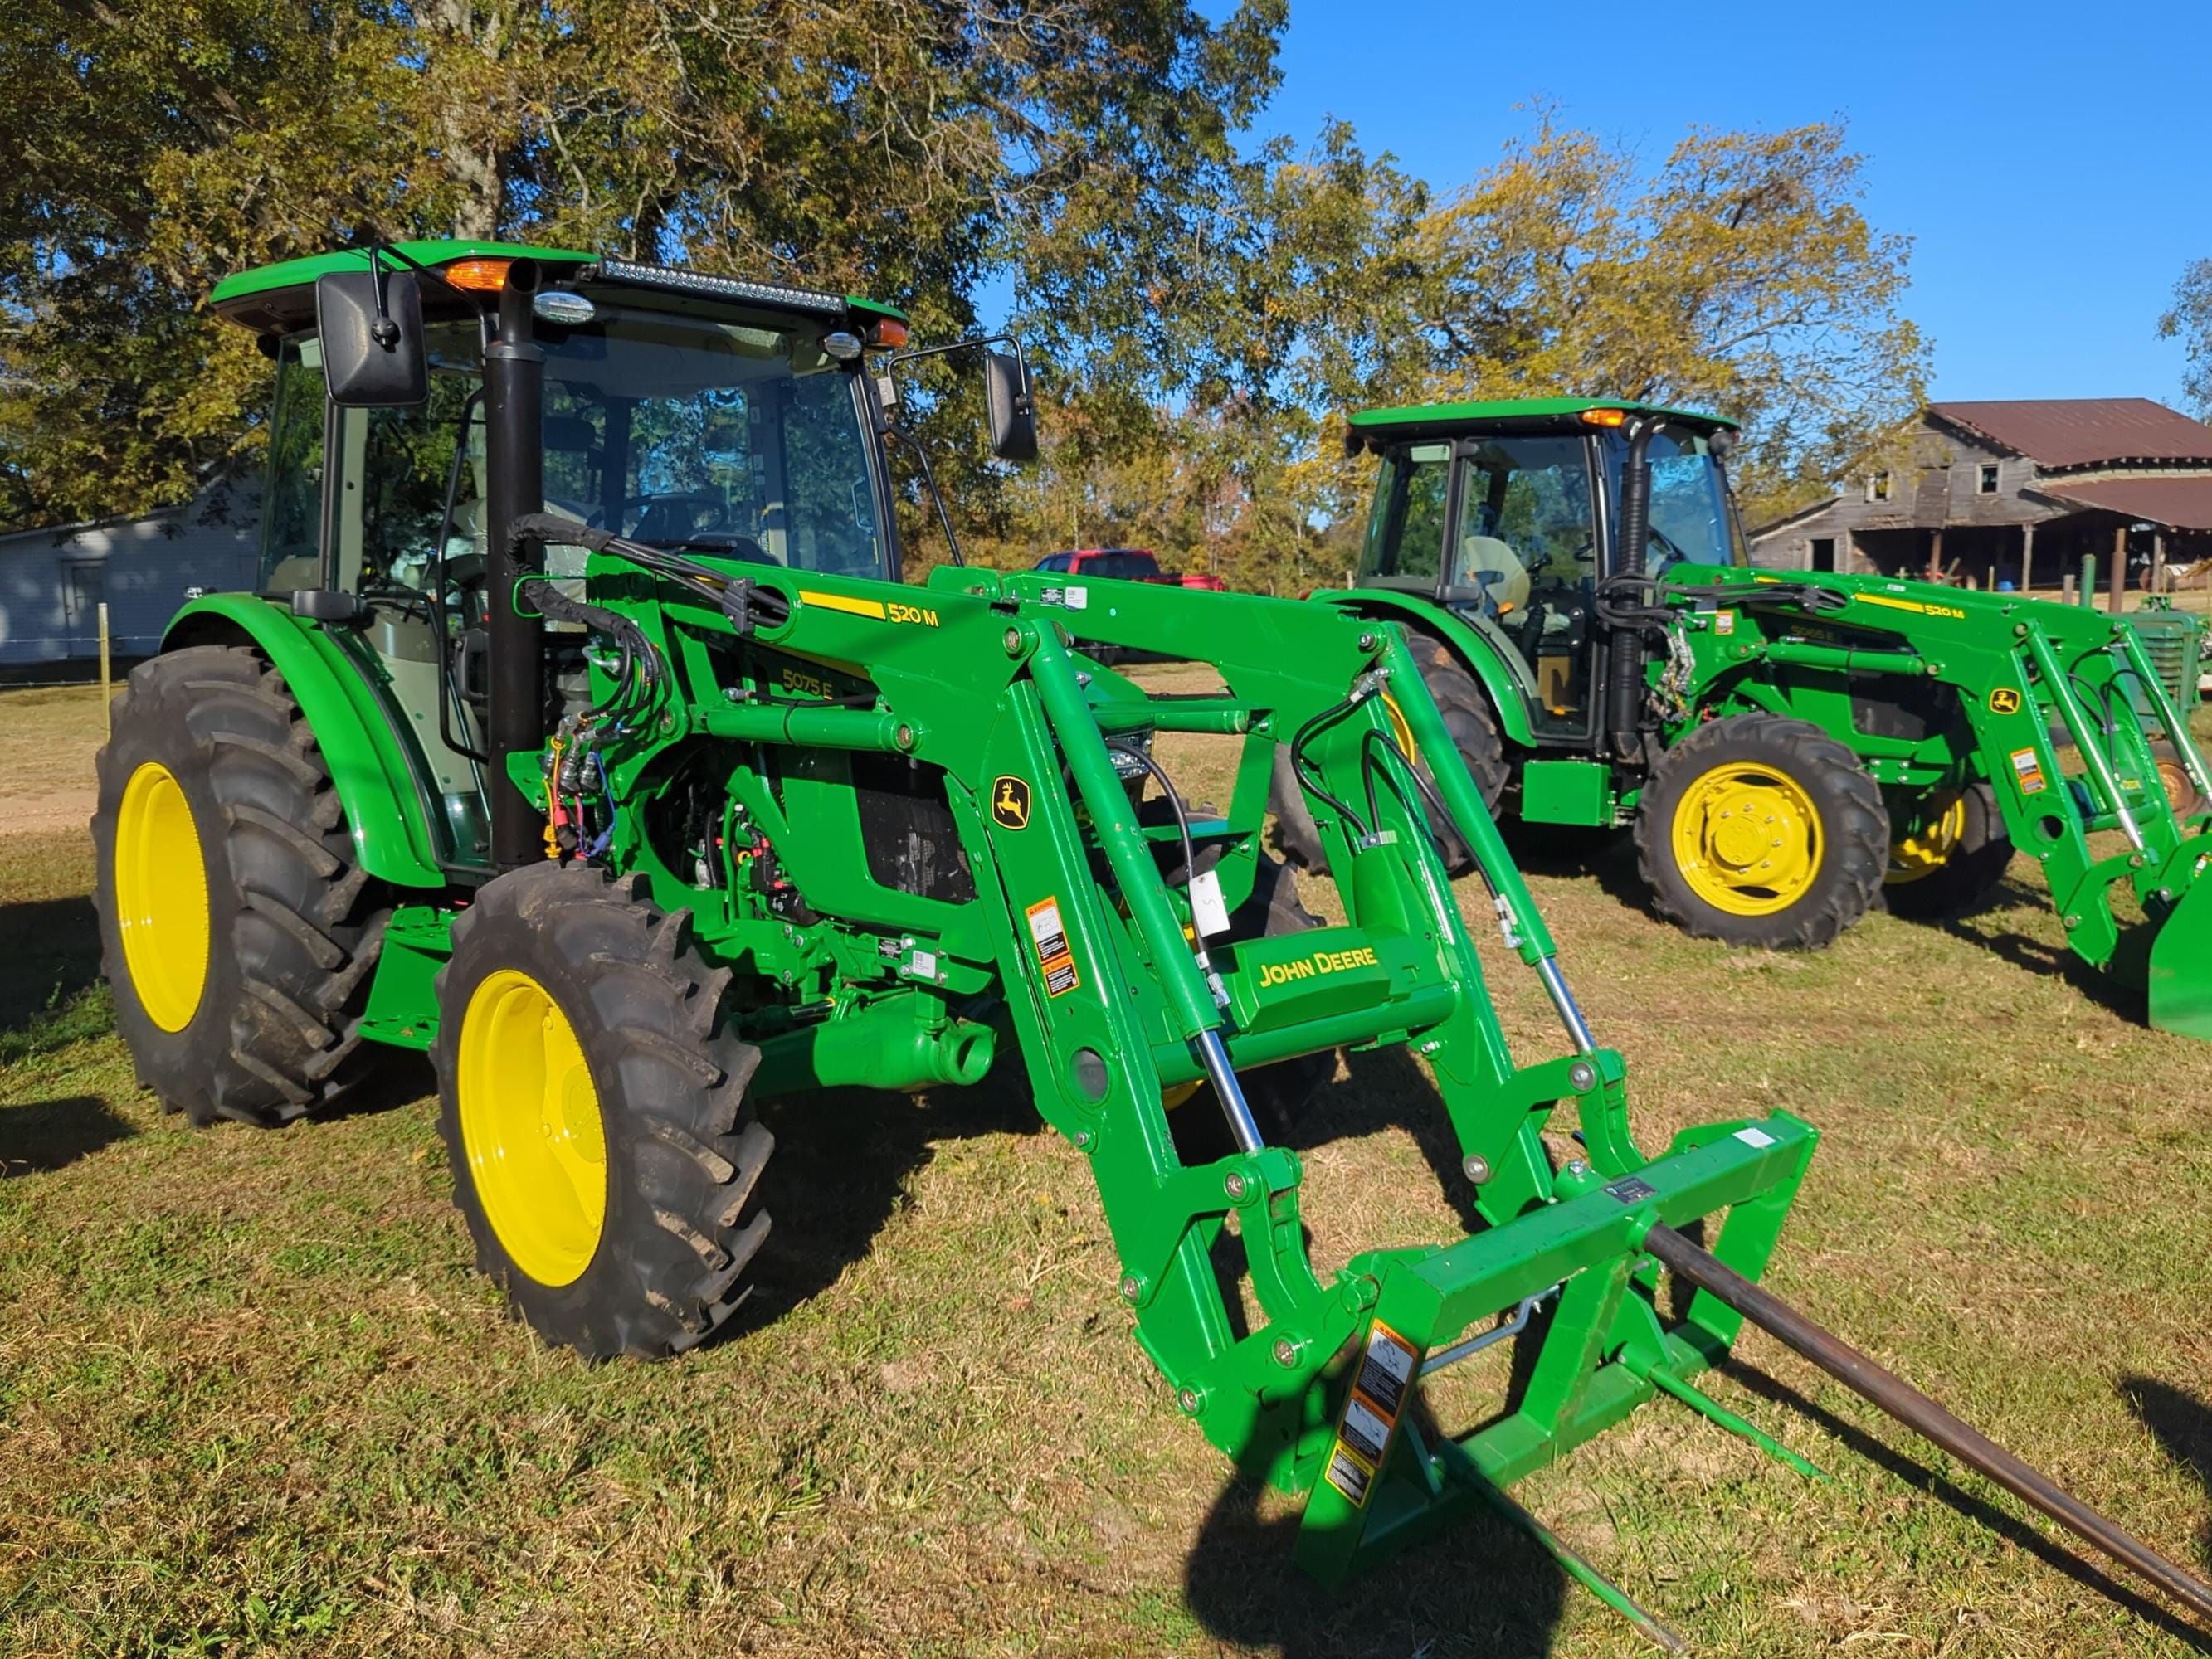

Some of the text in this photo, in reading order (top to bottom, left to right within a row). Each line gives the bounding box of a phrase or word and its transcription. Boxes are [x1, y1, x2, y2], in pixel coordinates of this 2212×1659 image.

[887, 602, 939, 627] 520 M
[1924, 605, 1966, 620] 520 M
[782, 668, 834, 701] 5075 E
[1259, 947, 1379, 988] JOHN DEERE
